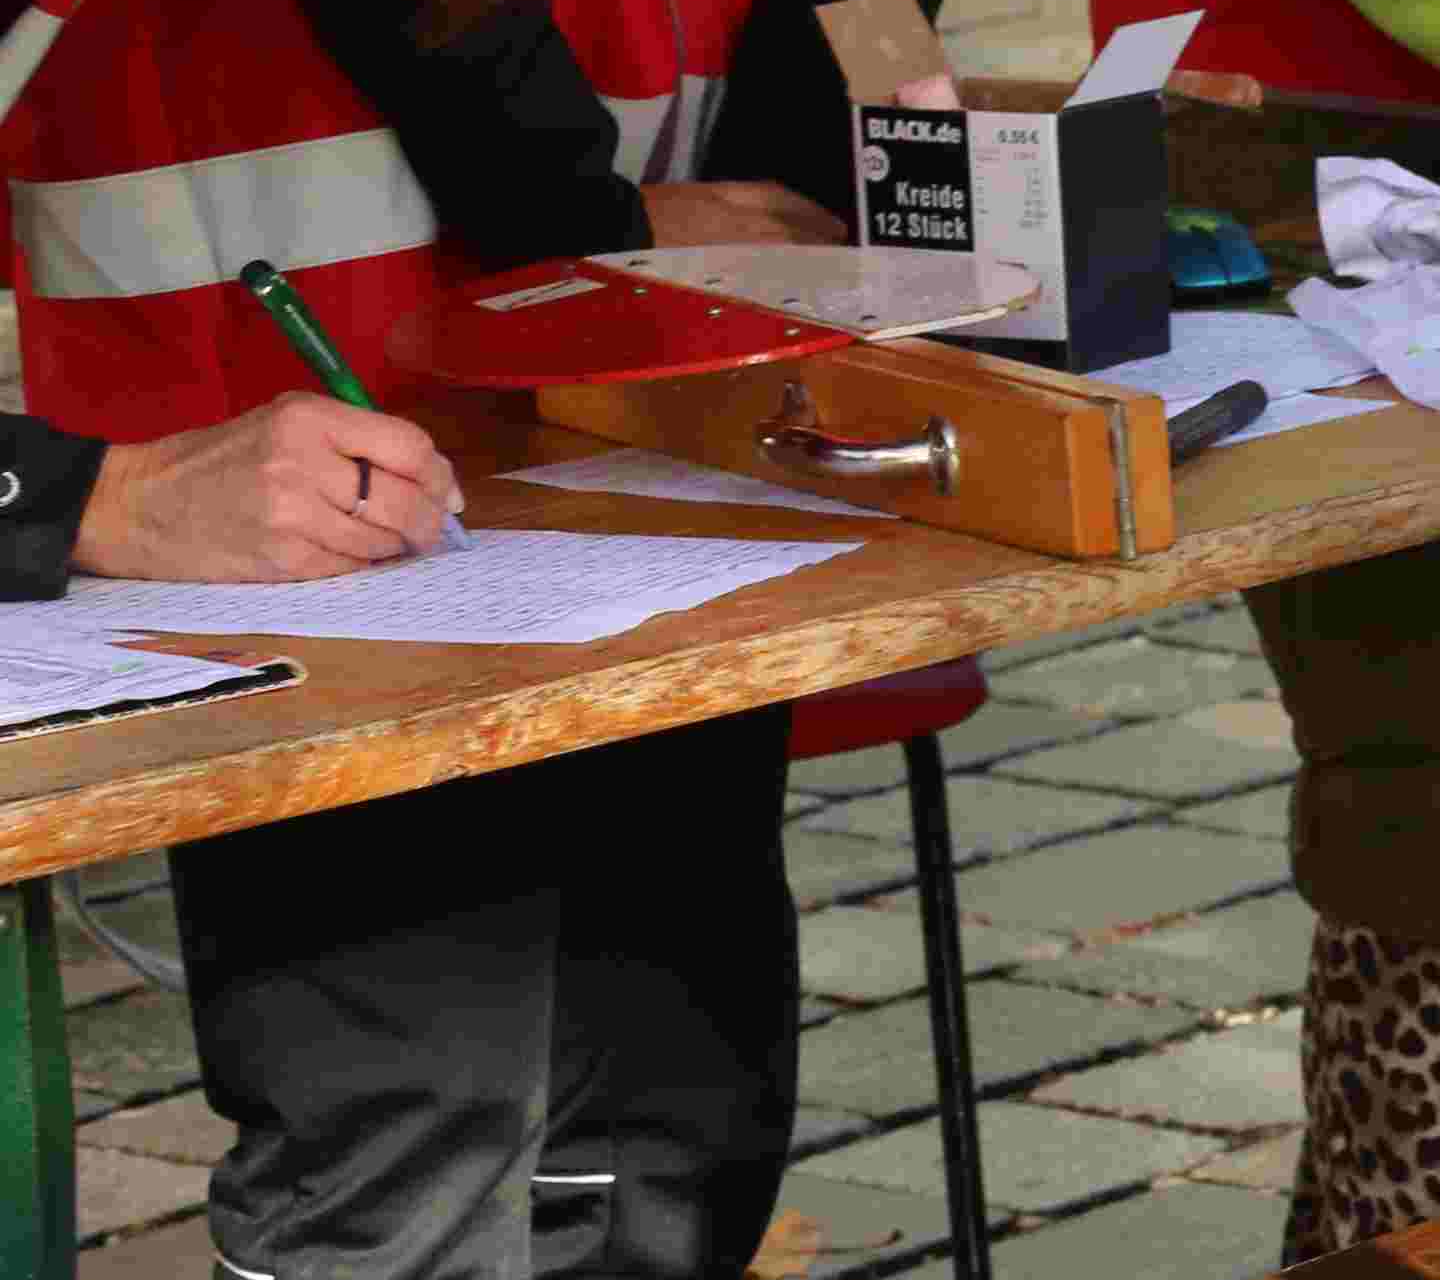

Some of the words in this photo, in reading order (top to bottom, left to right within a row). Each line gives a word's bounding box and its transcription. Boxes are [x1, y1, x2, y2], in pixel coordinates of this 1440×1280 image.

[896, 180, 965, 210] Kreide
[875, 212, 902, 236] 12
[908, 212, 968, 241] Stück
